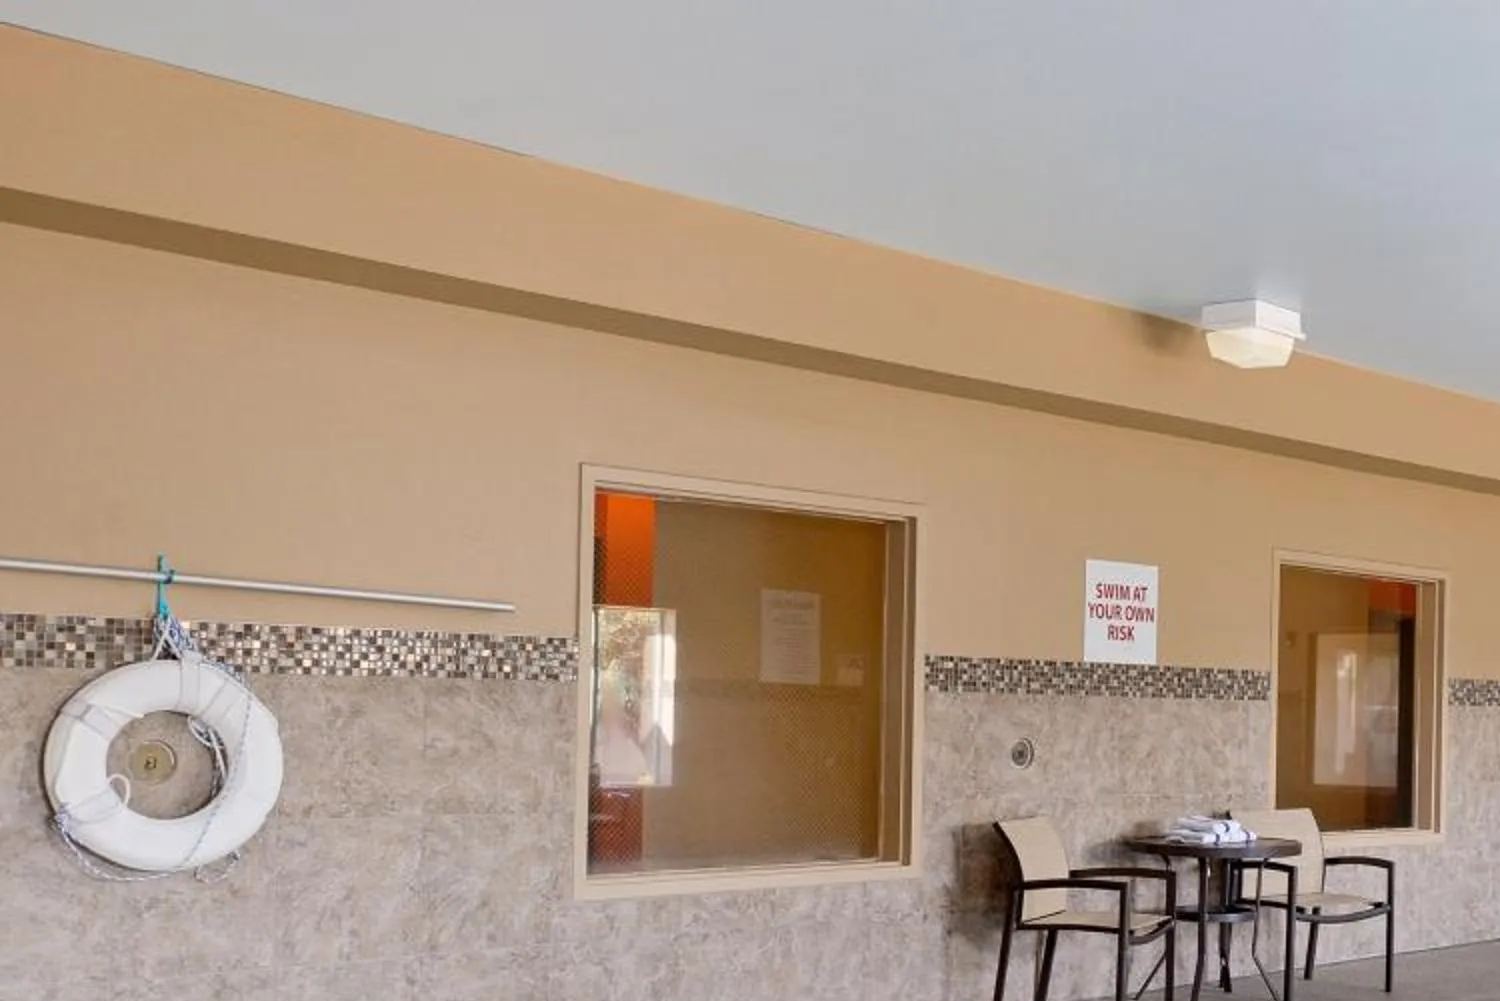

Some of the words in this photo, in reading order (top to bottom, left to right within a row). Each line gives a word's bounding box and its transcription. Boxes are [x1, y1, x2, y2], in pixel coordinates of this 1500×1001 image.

[1095, 583, 1131, 600] SWIM
[1133, 586, 1148, 601] AT
[1088, 602, 1122, 620] YOUR
[1125, 605, 1155, 622] OWN
[1107, 625, 1135, 641] RISK
